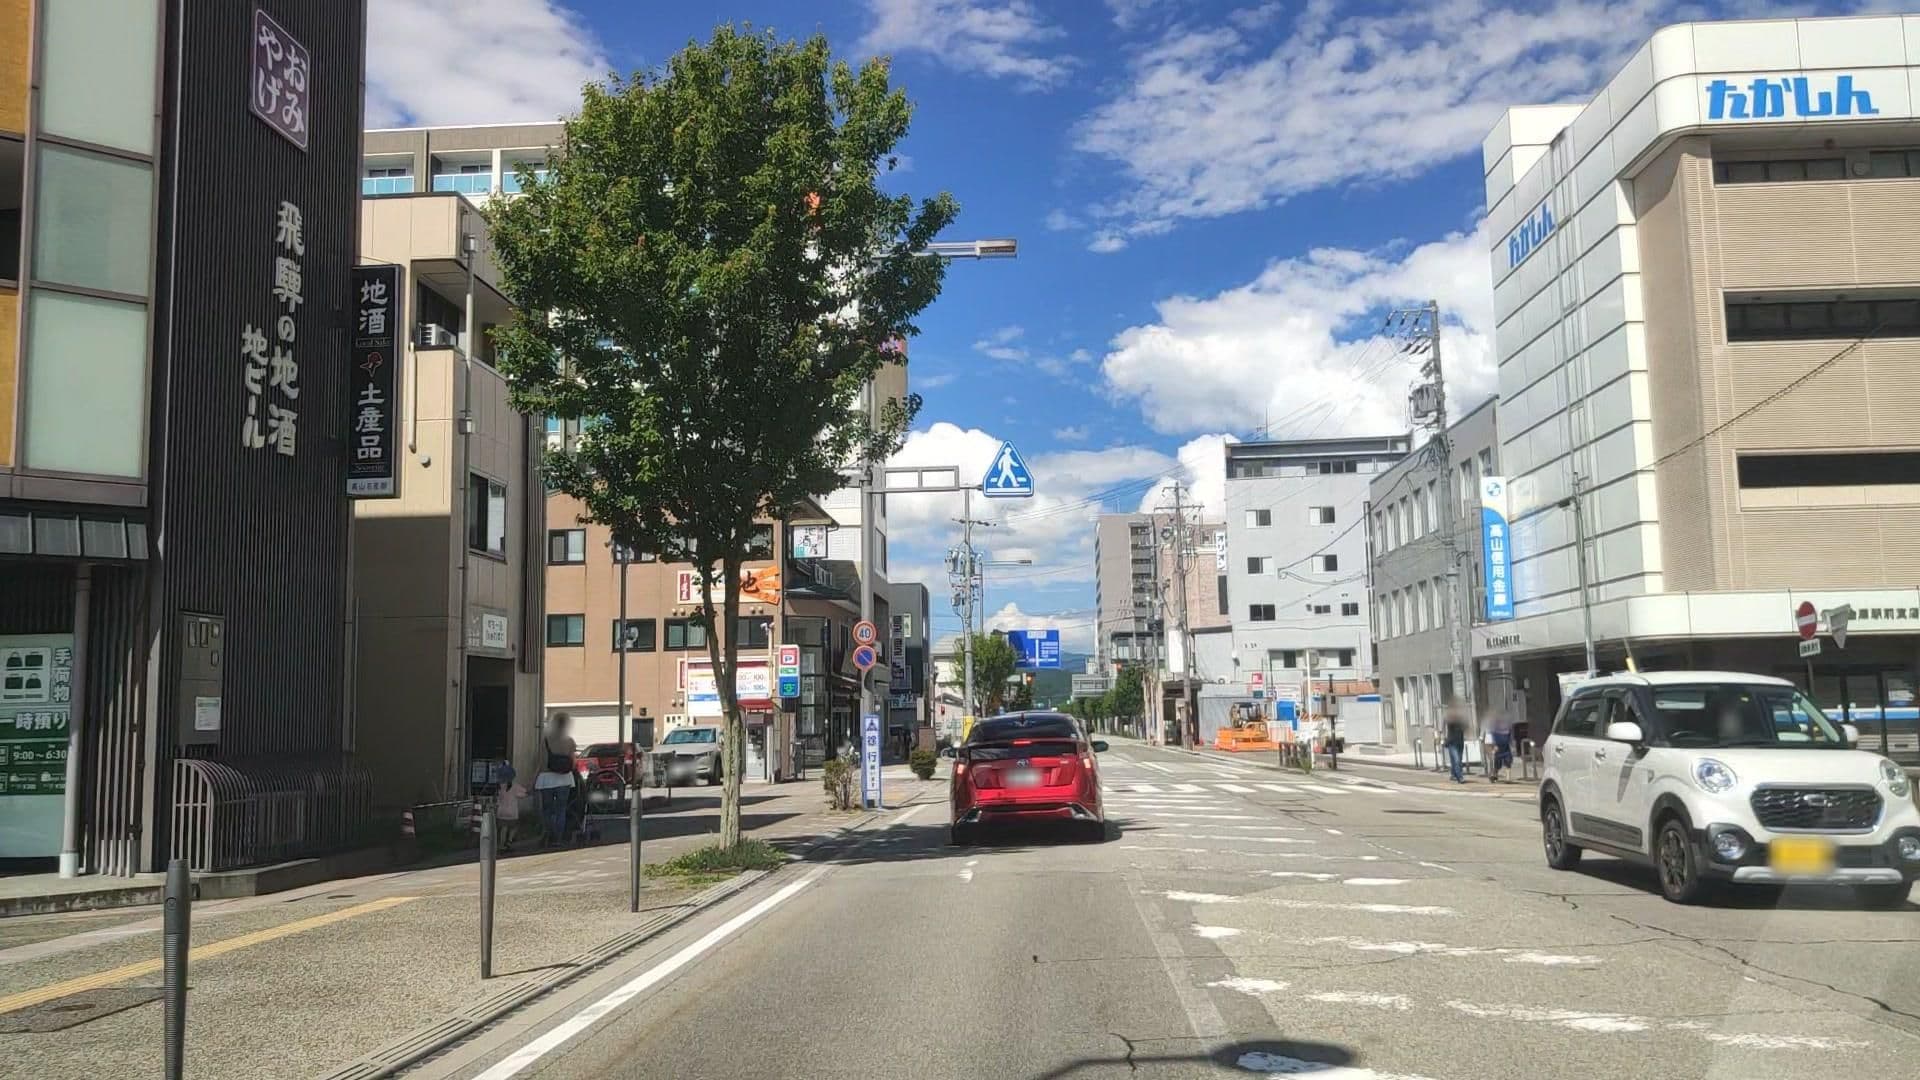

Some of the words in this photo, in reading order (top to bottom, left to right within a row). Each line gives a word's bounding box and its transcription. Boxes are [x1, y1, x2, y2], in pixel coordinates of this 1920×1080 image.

[1706, 75, 1880, 120] たかしん
[1508, 201, 1556, 269] たかしん
[268, 200, 305, 457] 飛騨の地酒
[359, 278, 389, 335] 地酒
[241, 323, 269, 449] 地ビール
[355, 382, 386, 460] 土産品
[1489, 524, 1507, 606] 高山信用金庫
[859, 628, 871, 639] 40
[53, 649, 72, 701] 手荷物
[0, 712, 67, 730] 一時預り
